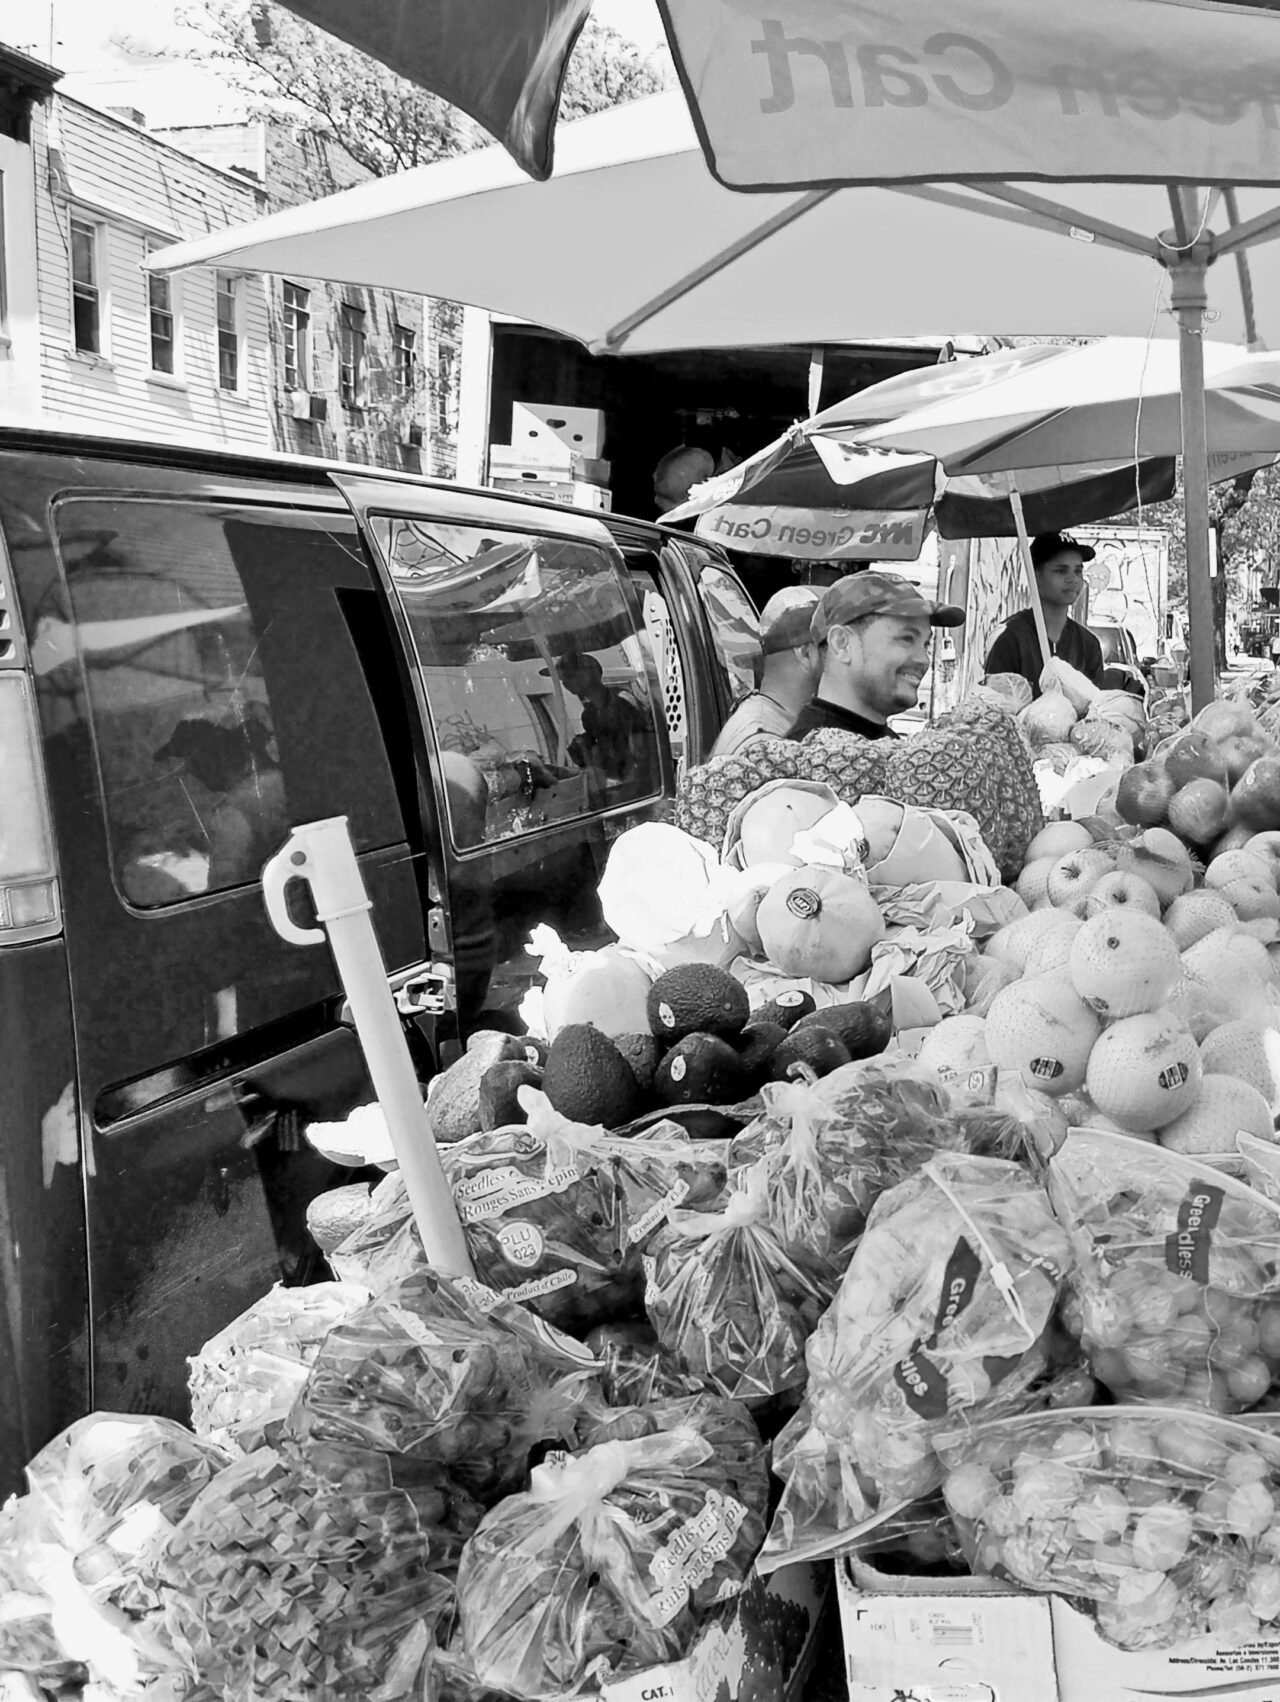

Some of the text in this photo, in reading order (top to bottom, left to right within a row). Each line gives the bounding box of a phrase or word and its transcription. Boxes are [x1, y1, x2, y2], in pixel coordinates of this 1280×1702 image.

[462, 1191, 510, 1220] Rouges
[508, 1183, 537, 1202] Sans
[506, 1281, 541, 1301] Product
[549, 1270, 574, 1289] Chile
[641, 1686, 669, 1701] CAT.
